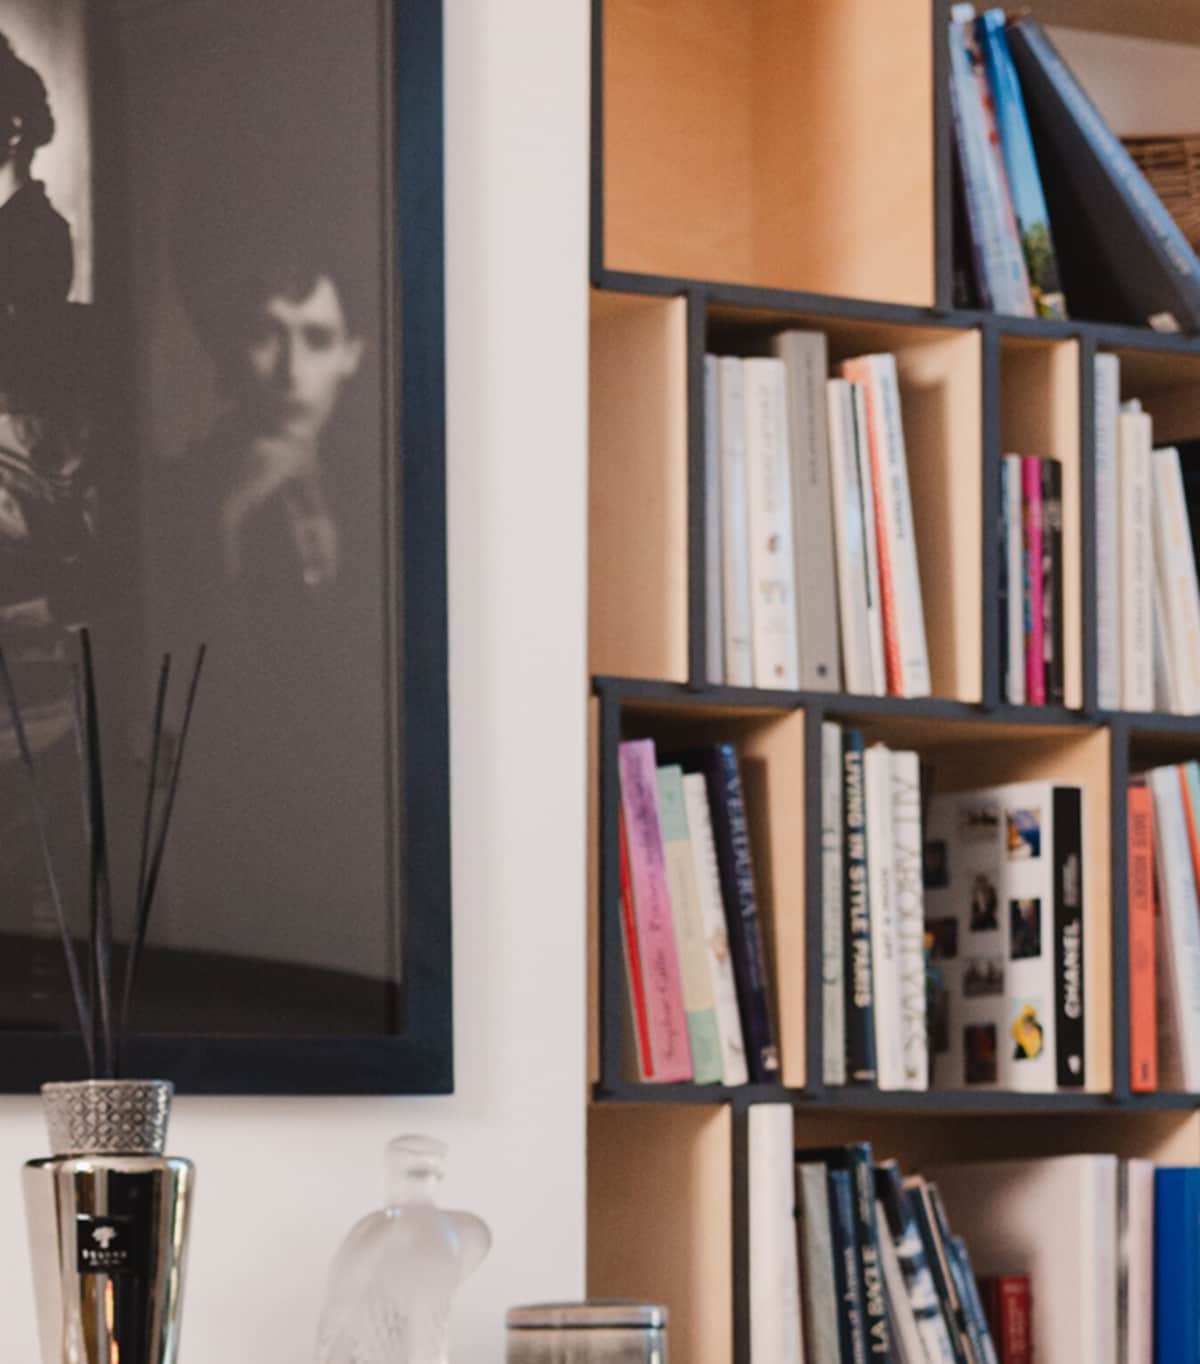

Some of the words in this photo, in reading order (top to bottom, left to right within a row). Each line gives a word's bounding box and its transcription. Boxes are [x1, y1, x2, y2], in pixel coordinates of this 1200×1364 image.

[846, 751, 866, 827] LIVING
[848, 833, 866, 860] IN
[850, 865, 869, 933] STYLE
[852, 939, 872, 1008] PARIS
[1063, 921, 1081, 1020] CHANEL
